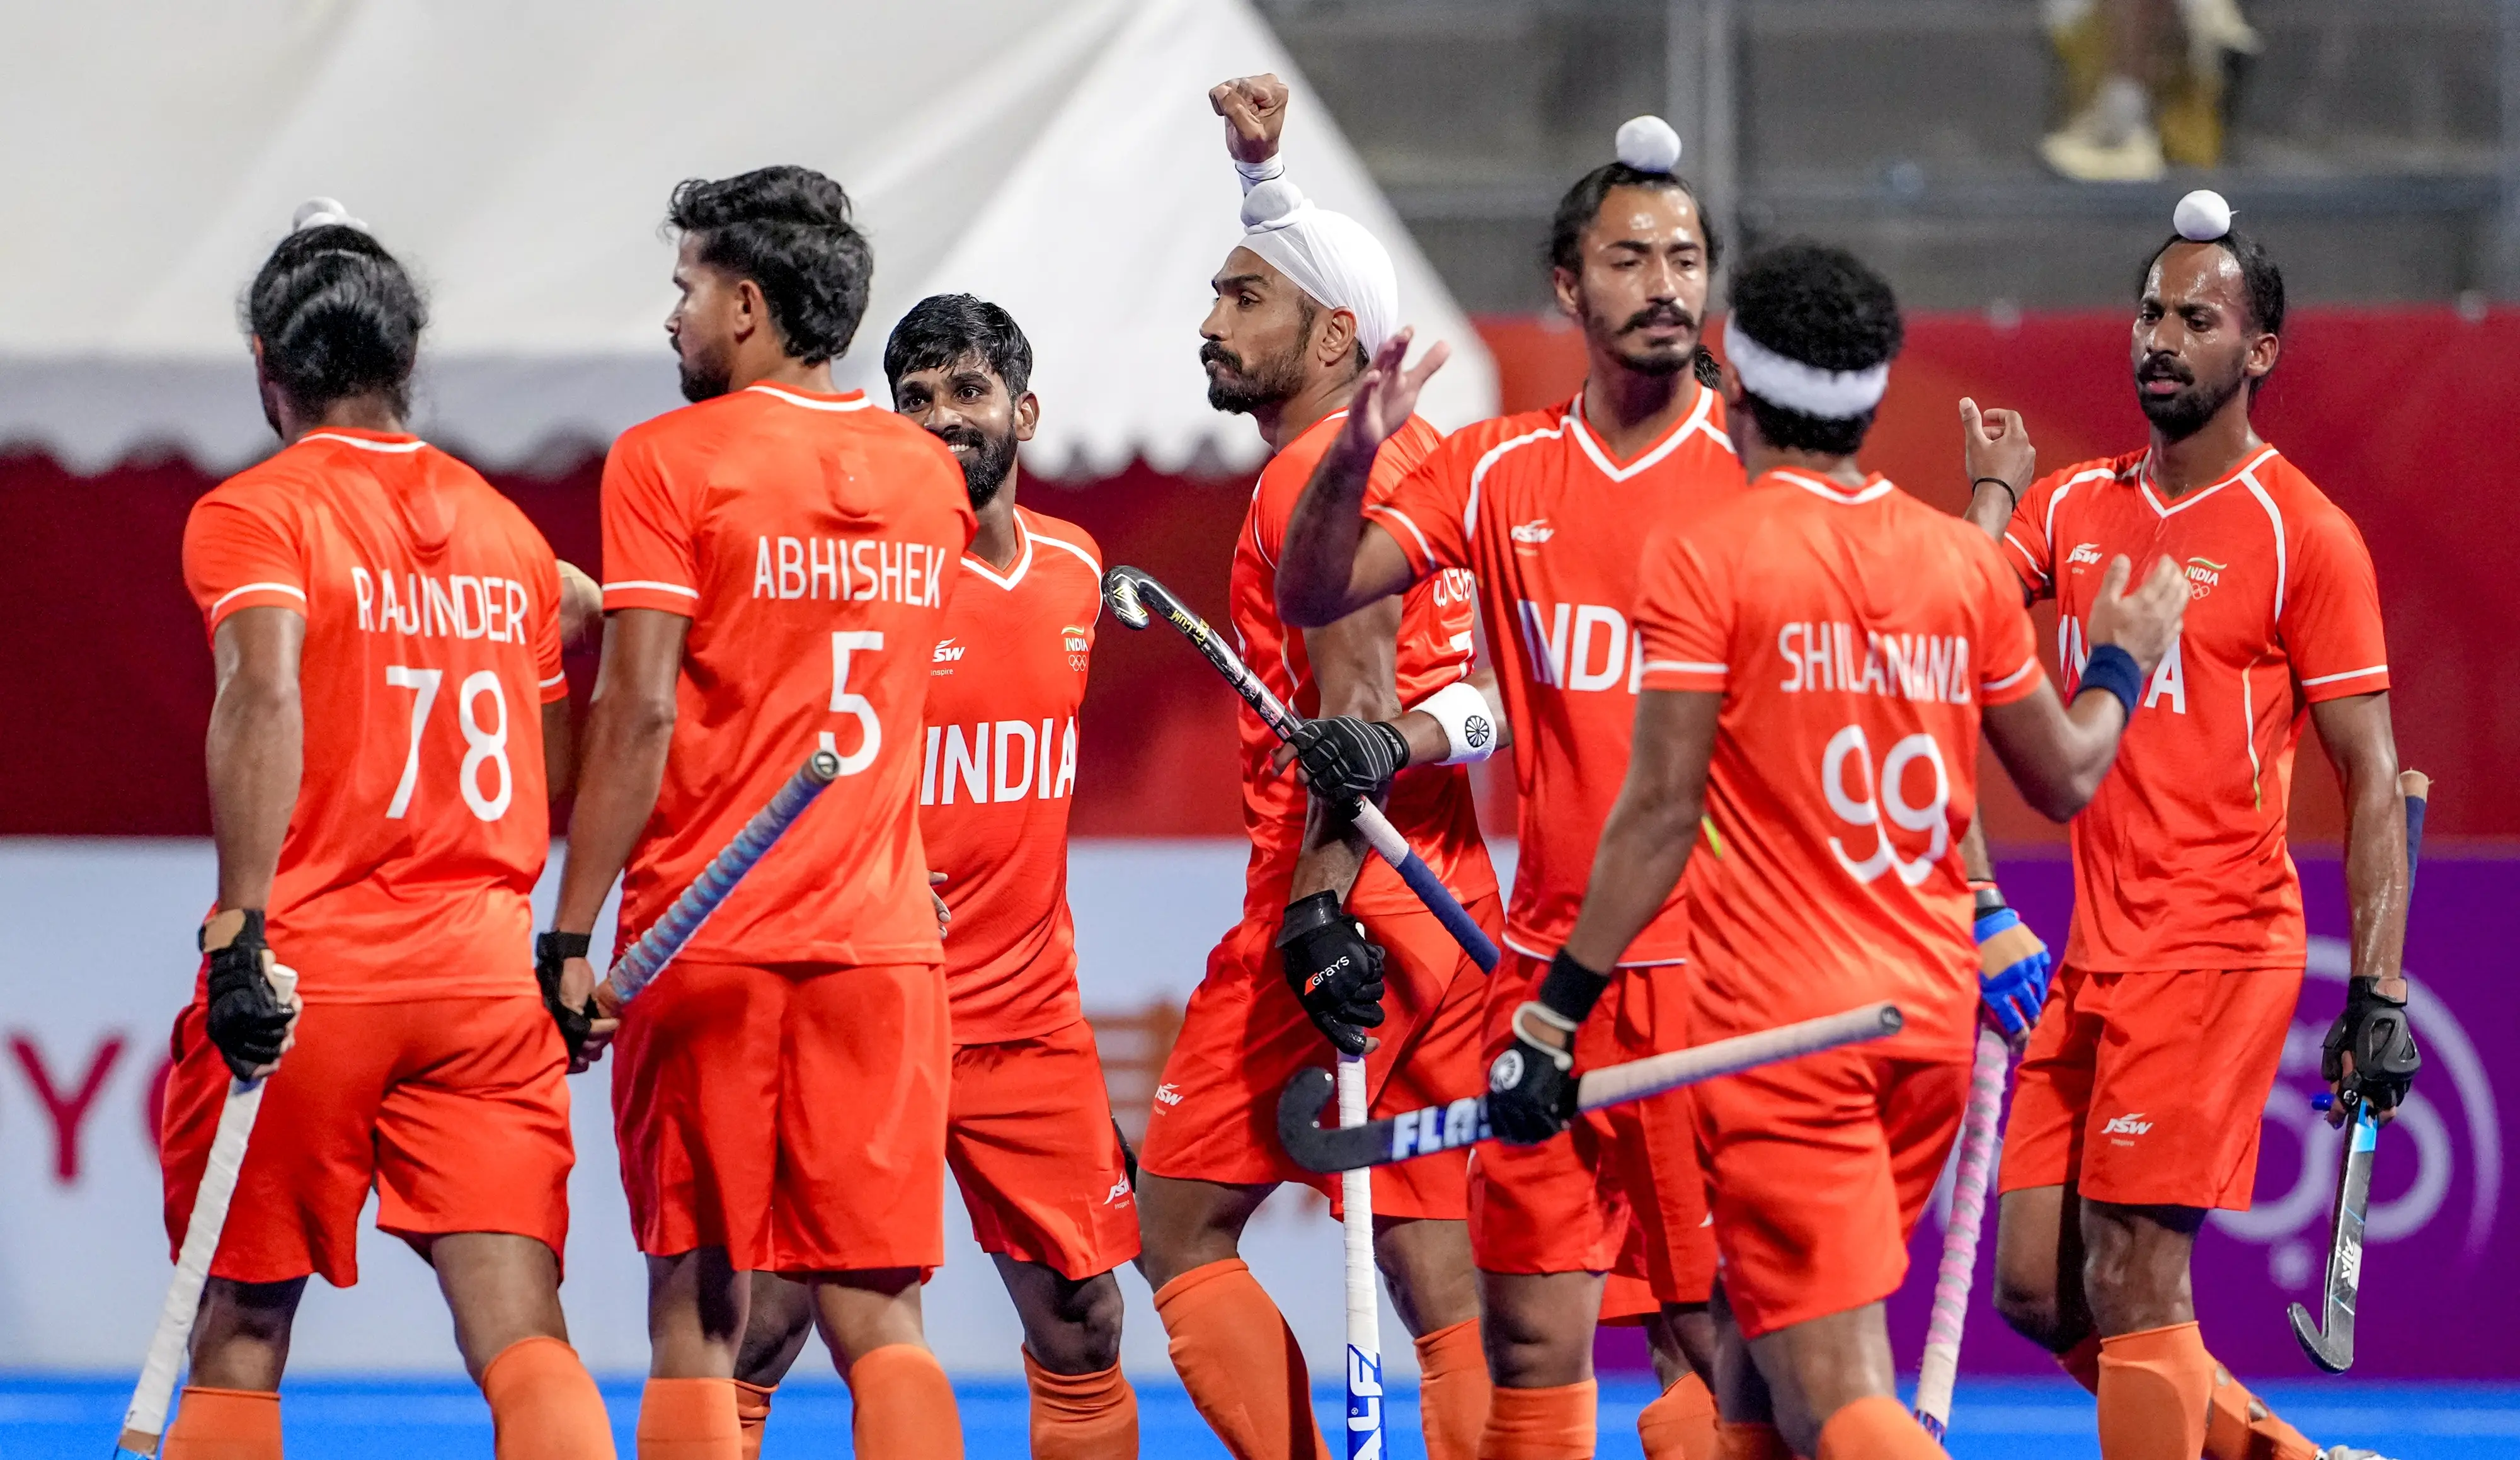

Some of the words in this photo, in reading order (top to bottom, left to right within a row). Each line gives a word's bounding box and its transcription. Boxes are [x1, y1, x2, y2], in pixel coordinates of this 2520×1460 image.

[351, 566, 528, 645] RAJINDER
[752, 535, 946, 609] ABHISHEK
[1063, 637, 1090, 652] INDIA
[386, 665, 512, 822] 78
[819, 630, 885, 777] 5
[920, 716, 1077, 806] INDIA
[1821, 724, 1950, 886] 99
[2101, 1118, 2153, 1135] JSW
